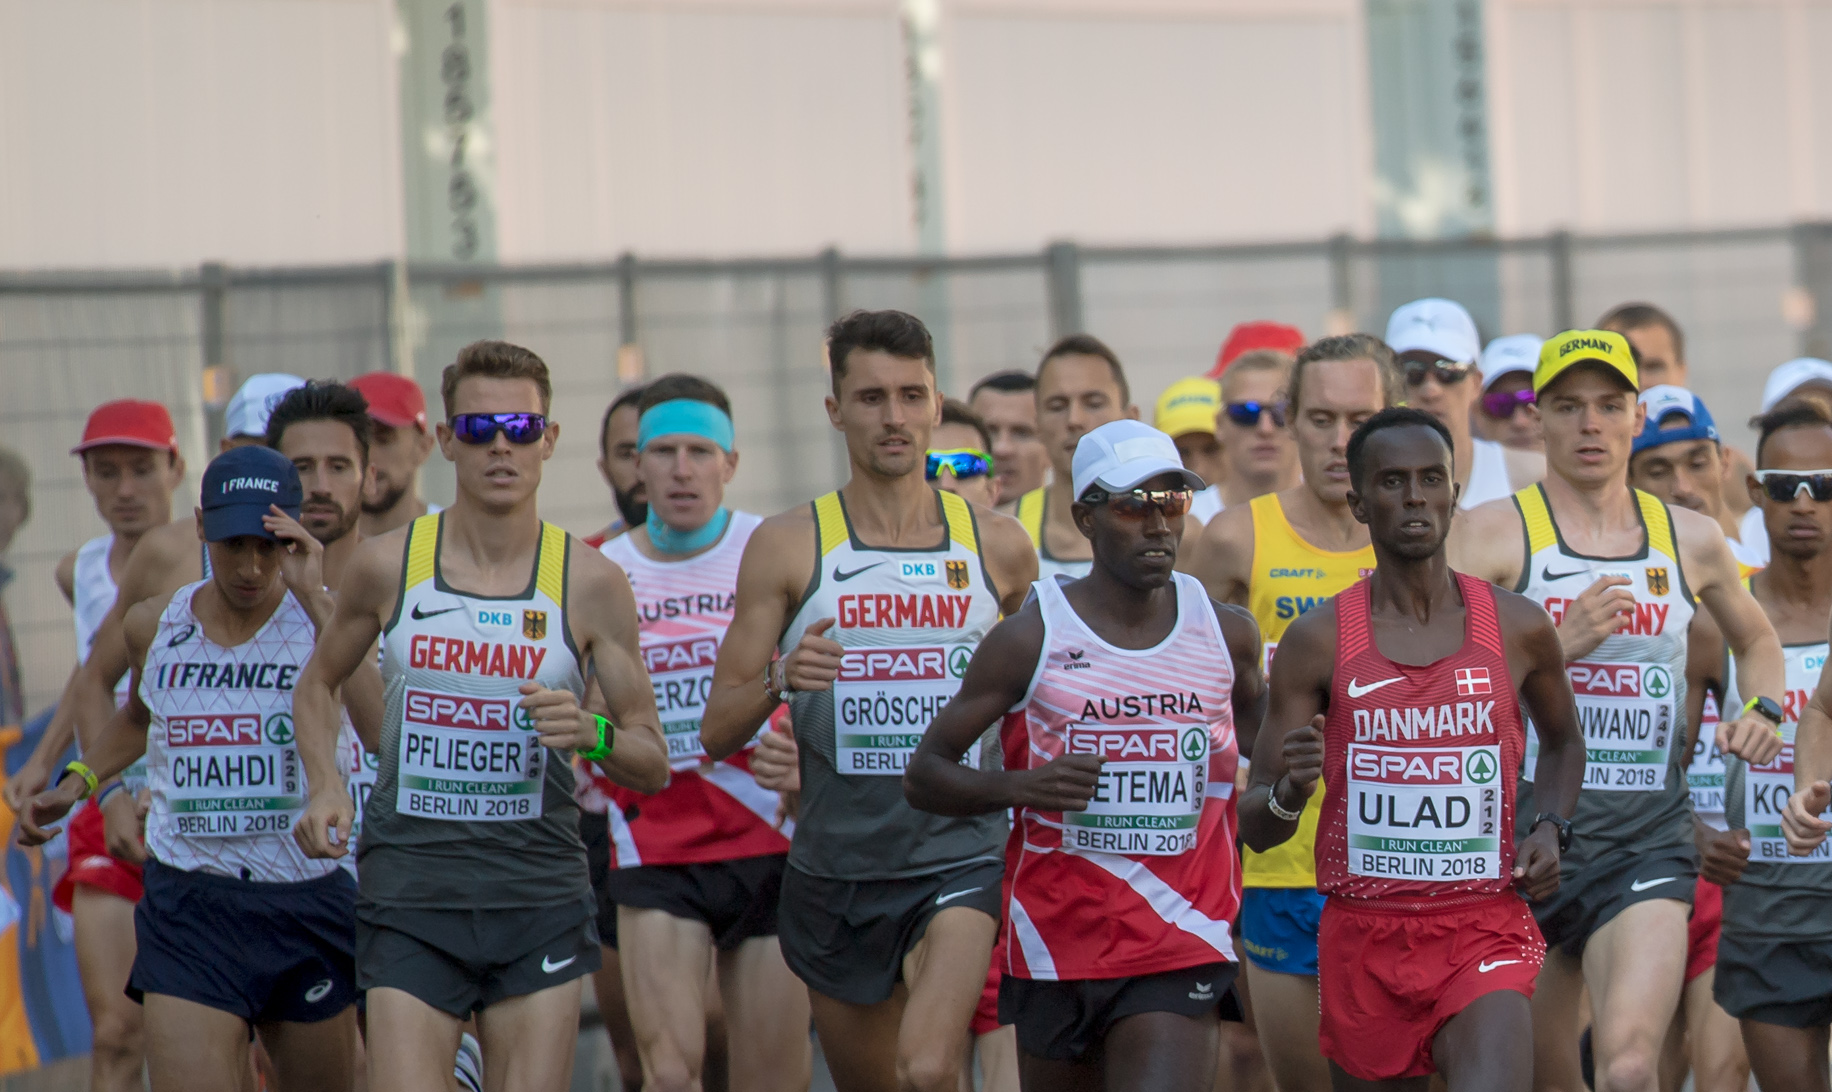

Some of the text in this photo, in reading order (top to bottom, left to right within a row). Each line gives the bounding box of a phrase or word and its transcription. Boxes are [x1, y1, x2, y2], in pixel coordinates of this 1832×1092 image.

[1559, 338, 1613, 358] GERMANY
[229, 477, 280, 493] FRANCE
[902, 563, 936, 576] DKB
[1269, 568, 1314, 578] CRAFT
[478, 611, 513, 626] DKB
[637, 592, 736, 624] USTRIA
[837, 593, 972, 629] GERMANY
[409, 633, 547, 680] GERMANY
[641, 640, 717, 671] PAR
[840, 651, 944, 678] SPAR
[1063, 661, 1091, 670] erima
[180, 662, 299, 690] FRANCE
[1566, 665, 1639, 693] PAR
[653, 676, 713, 712] ERZO
[1080, 692, 1203, 721] AUSTRIA
[408, 694, 507, 727] SPAR
[1353, 700, 1495, 742] DANMARK
[168, 717, 260, 743] SPAR
[877, 735, 906, 747] RUN
[405, 732, 521, 773] PFLIEGER
[1071, 733, 1176, 758] SPAR
[173, 754, 275, 788] CHAHDI
[284, 749, 297, 793] 229
[1354, 752, 1460, 781] SPAR
[1615, 768, 1656, 785] 2018
[433, 779, 463, 792] RUN
[1093, 770, 1188, 804] ETEMA
[1194, 765, 1203, 810] 203
[195, 799, 220, 810] RUN
[409, 793, 530, 817] BERLIN 2018
[1359, 791, 1471, 829] ULAD
[1482, 789, 1495, 834] 212
[177, 814, 290, 834] BERLIN 2018
[1104, 816, 1132, 828] RUN
[1077, 830, 1148, 851] BERLIN
[1388, 839, 1417, 851] RUN
[1362, 853, 1486, 877] BERLIN 2018
